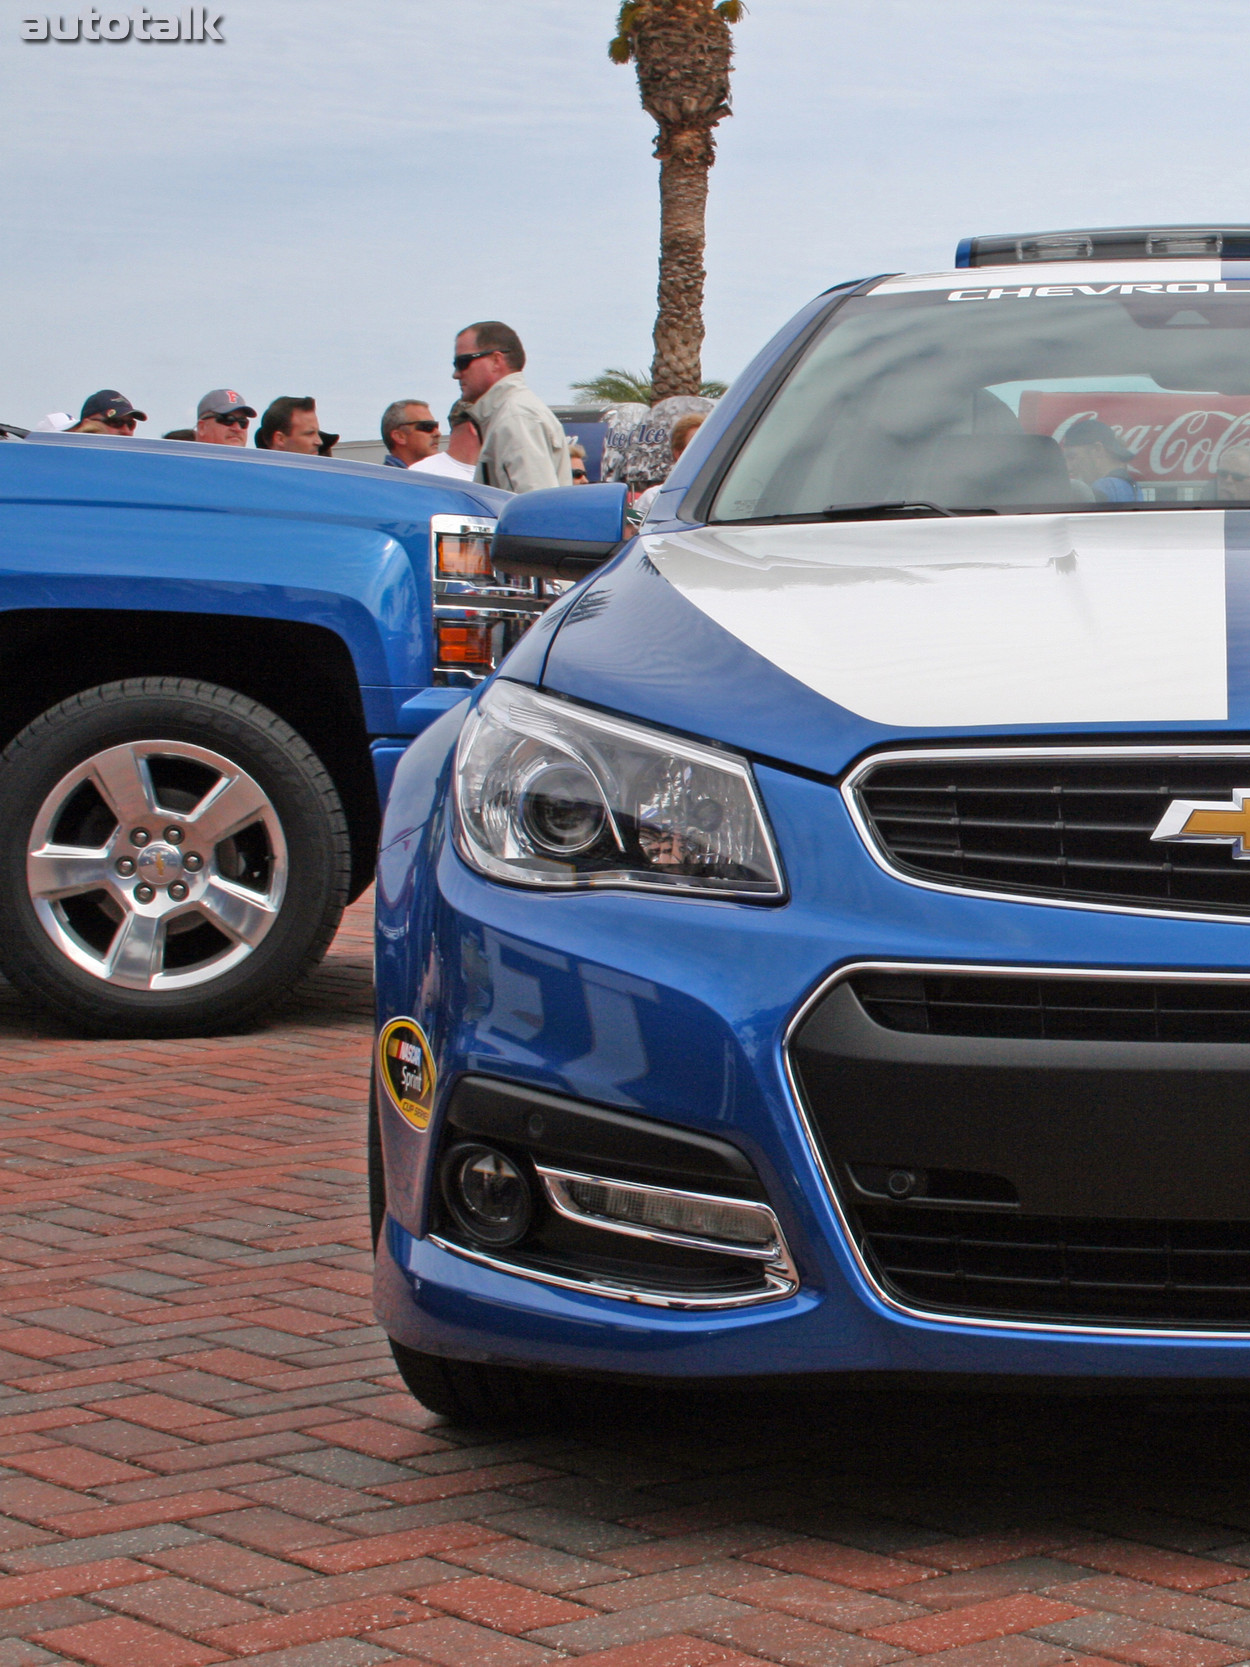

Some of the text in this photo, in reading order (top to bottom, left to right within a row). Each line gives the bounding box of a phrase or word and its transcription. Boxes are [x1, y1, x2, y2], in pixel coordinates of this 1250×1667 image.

[607, 427, 627, 447] Ice
[638, 424, 667, 444] Ice
[401, 1065, 422, 1092] Sprint
